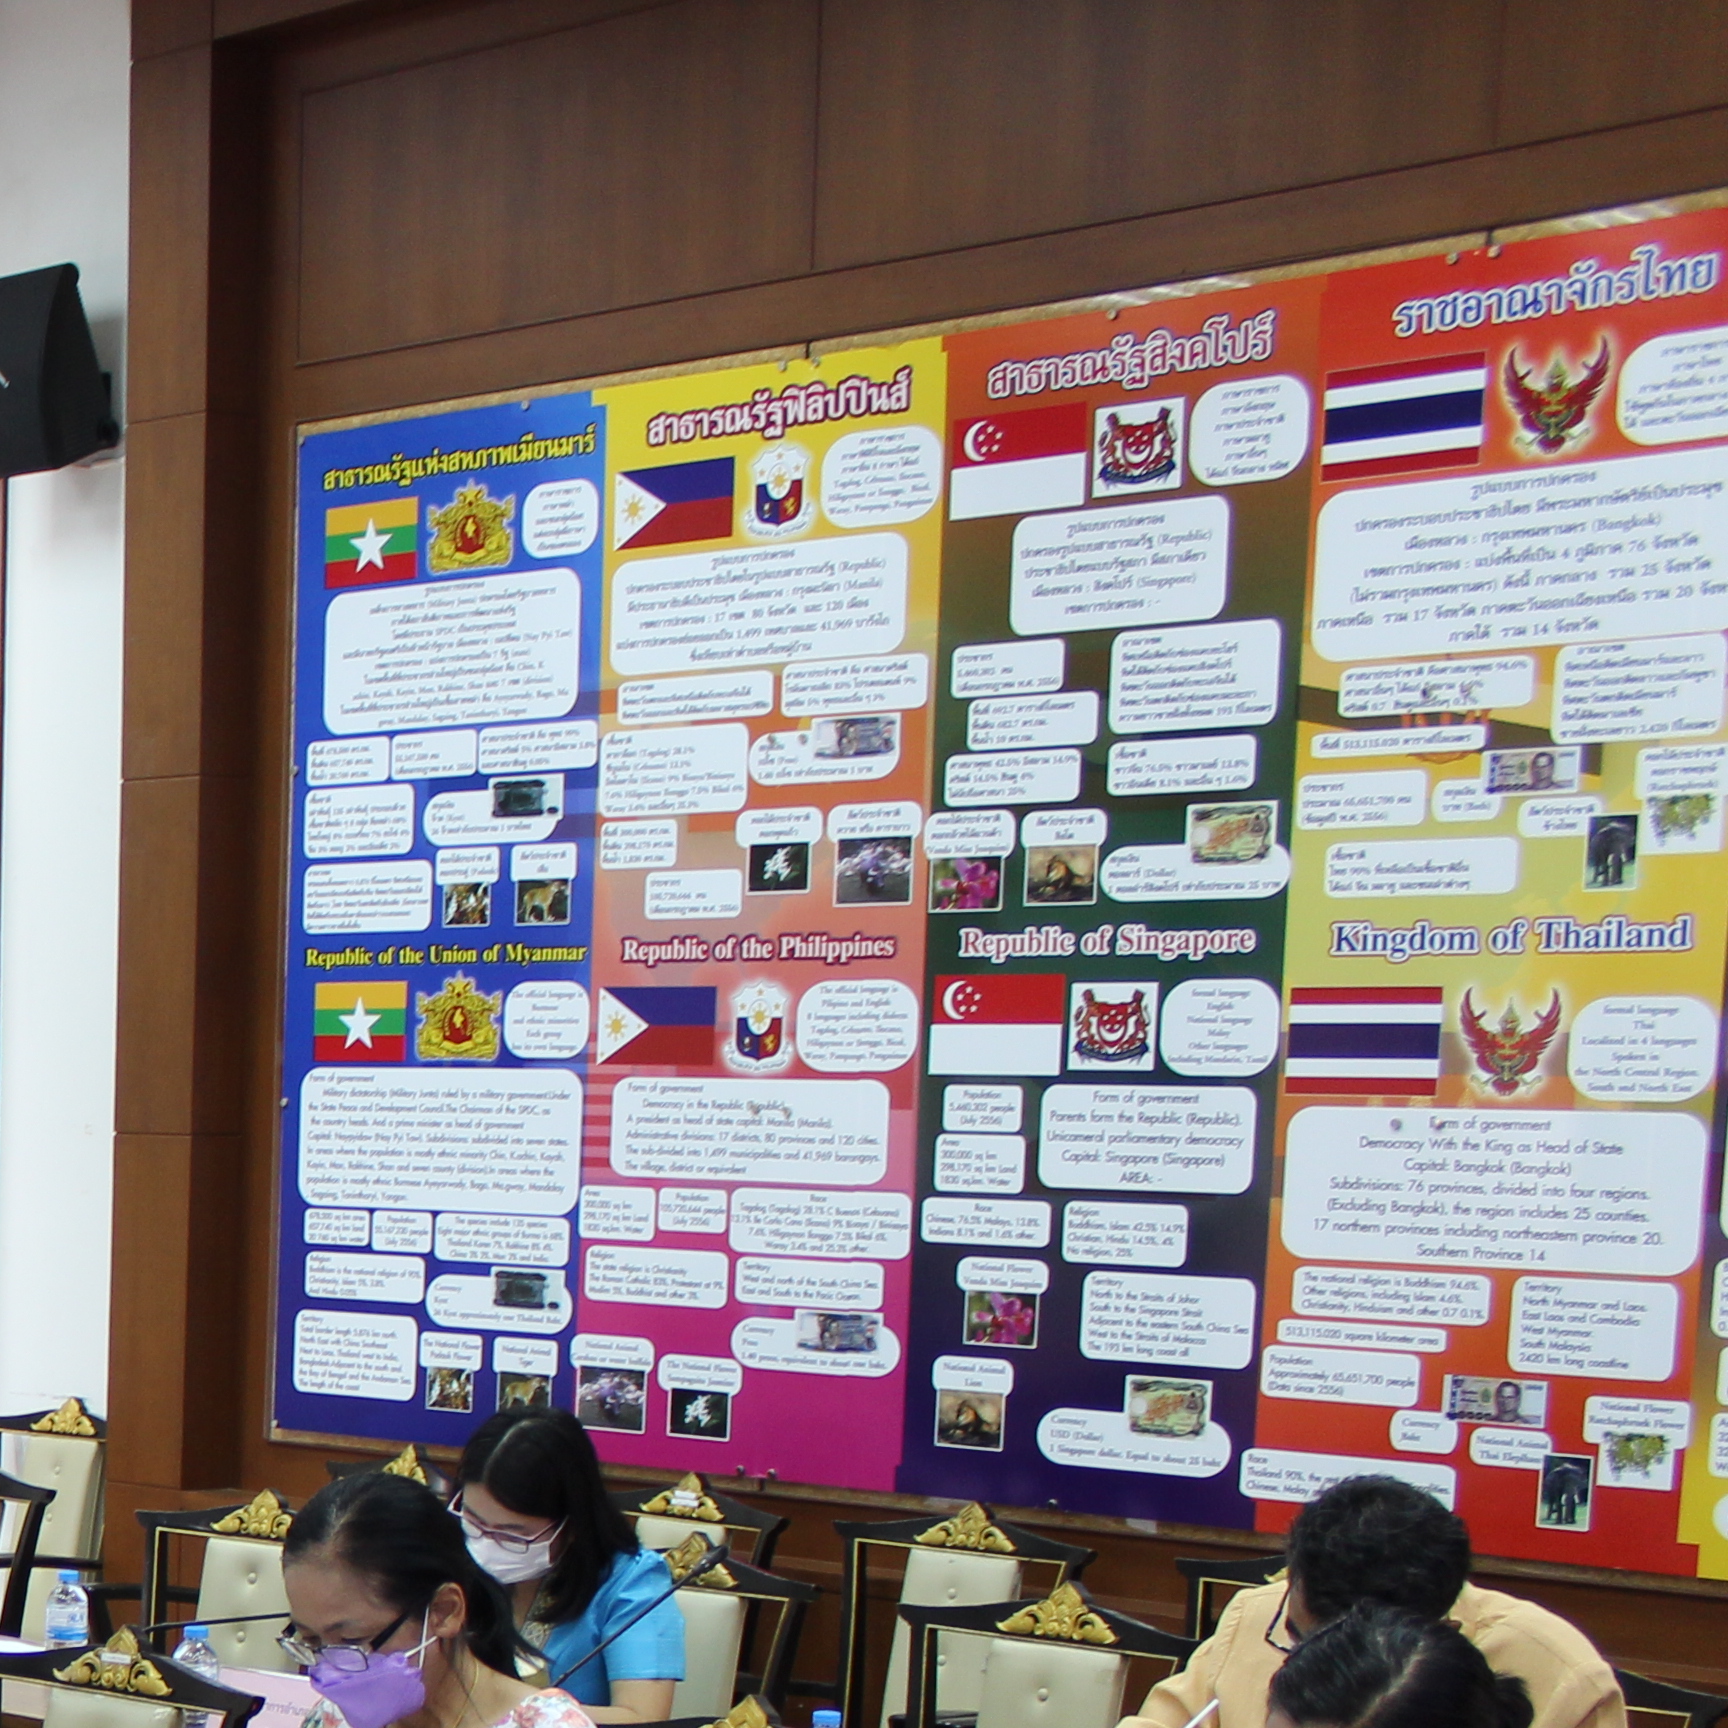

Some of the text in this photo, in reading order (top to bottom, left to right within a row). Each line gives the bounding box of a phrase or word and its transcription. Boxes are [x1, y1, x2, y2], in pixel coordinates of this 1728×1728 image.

[1392, 243, 1720, 337] ราชอาณาจักรไทย
[987, 309, 1277, 399] สาธารณรัฐสิงคโปร์
[647, 366, 912, 447] สาธารณรัฐฟิลิปปินส์
[323, 423, 596, 491] สาธารณรัฐแห่งสหภาพเมียนมาร์
[1561, 548, 1571, 559] 4
[1629, 539, 1648, 552] 76
[1652, 531, 1701, 549] จังหวัด
[1641, 562, 1660, 577] 25
[1664, 554, 1714, 573] จังหวัด
[1414, 607, 1430, 621] 17
[1675, 584, 1695, 599] 20
[1533, 623, 1551, 635] 14
[1554, 616, 1601, 633] จังหวัด
[959, 924, 1257, 963] Republic of Singapore
[1330, 913, 1693, 962] Kingdom of Thailand
[305, 944, 587, 970] Republic of the Union of Myanmar
[622, 933, 895, 966] Republic of the Philippines
[1633, 1019, 1657, 1029] Thai
[1627, 1037, 1640, 1046] in
[1592, 1066, 1623, 1077] North
[627, 1082, 705, 1095] Form of government
[1617, 1083, 1637, 1092] and
[1638, 1083, 1670, 1092] North
[1671, 1083, 1694, 1092] East
[1092, 1090, 1201, 1107] Form of government
[1049, 1109, 1087, 1122] Parents
[1089, 1110, 1115, 1123] form
[1117, 1111, 1135, 1123] the
[1137, 1111, 1184, 1126] Republic
[1463, 1116, 1478, 1130] of
[1479, 1120, 1552, 1134] government
[1184, 1133, 1245, 1149] democracy
[1359, 1135, 1627, 1156] Democracy With the King as Head of State
[1105, 1150, 1160, 1167] Singapore
[1161, 1152, 1227, 1169] (Singapore)
[1453, 1159, 1507, 1177] Bangkok
[1509, 1160, 1573, 1178] (Bangkok)
[1407, 1178, 1426, 1193] 76
[1491, 1180, 1539, 1196] divided
[1541, 1184, 1566, 1197] into
[1569, 1183, 1598, 1199] four
[1326, 1197, 1388, 1217] (Excluding
[1452, 1201, 1473, 1215] the
[1475, 1204, 1516, 1220] region
[1519, 1204, 1570, 1220] includes
[1573, 1206, 1593, 1221] 25
[1314, 1217, 1330, 1231] 17
[1332, 1218, 1382, 1233] northern
[1384, 1222, 1441, 1237] provinces
[1443, 1222, 1500, 1242] including
[1502, 1226, 1580, 1242] northeastern
[1581, 1230, 1640, 1246] province
[1416, 1243, 1547, 1261] Southern Province 14
[1524, 1281, 1564, 1296] Territory
[1522, 1296, 1551, 1306] North
[1552, 1298, 1599, 1310] Myanmar
[1600, 1299, 1621, 1311] and
[1521, 1310, 1543, 1320] East
[1566, 1313, 1588, 1324] and
[1521, 1324, 1546, 1335] West
[1519, 1338, 1547, 1349] South
[1600, 1402, 1677, 1414] National Flower
